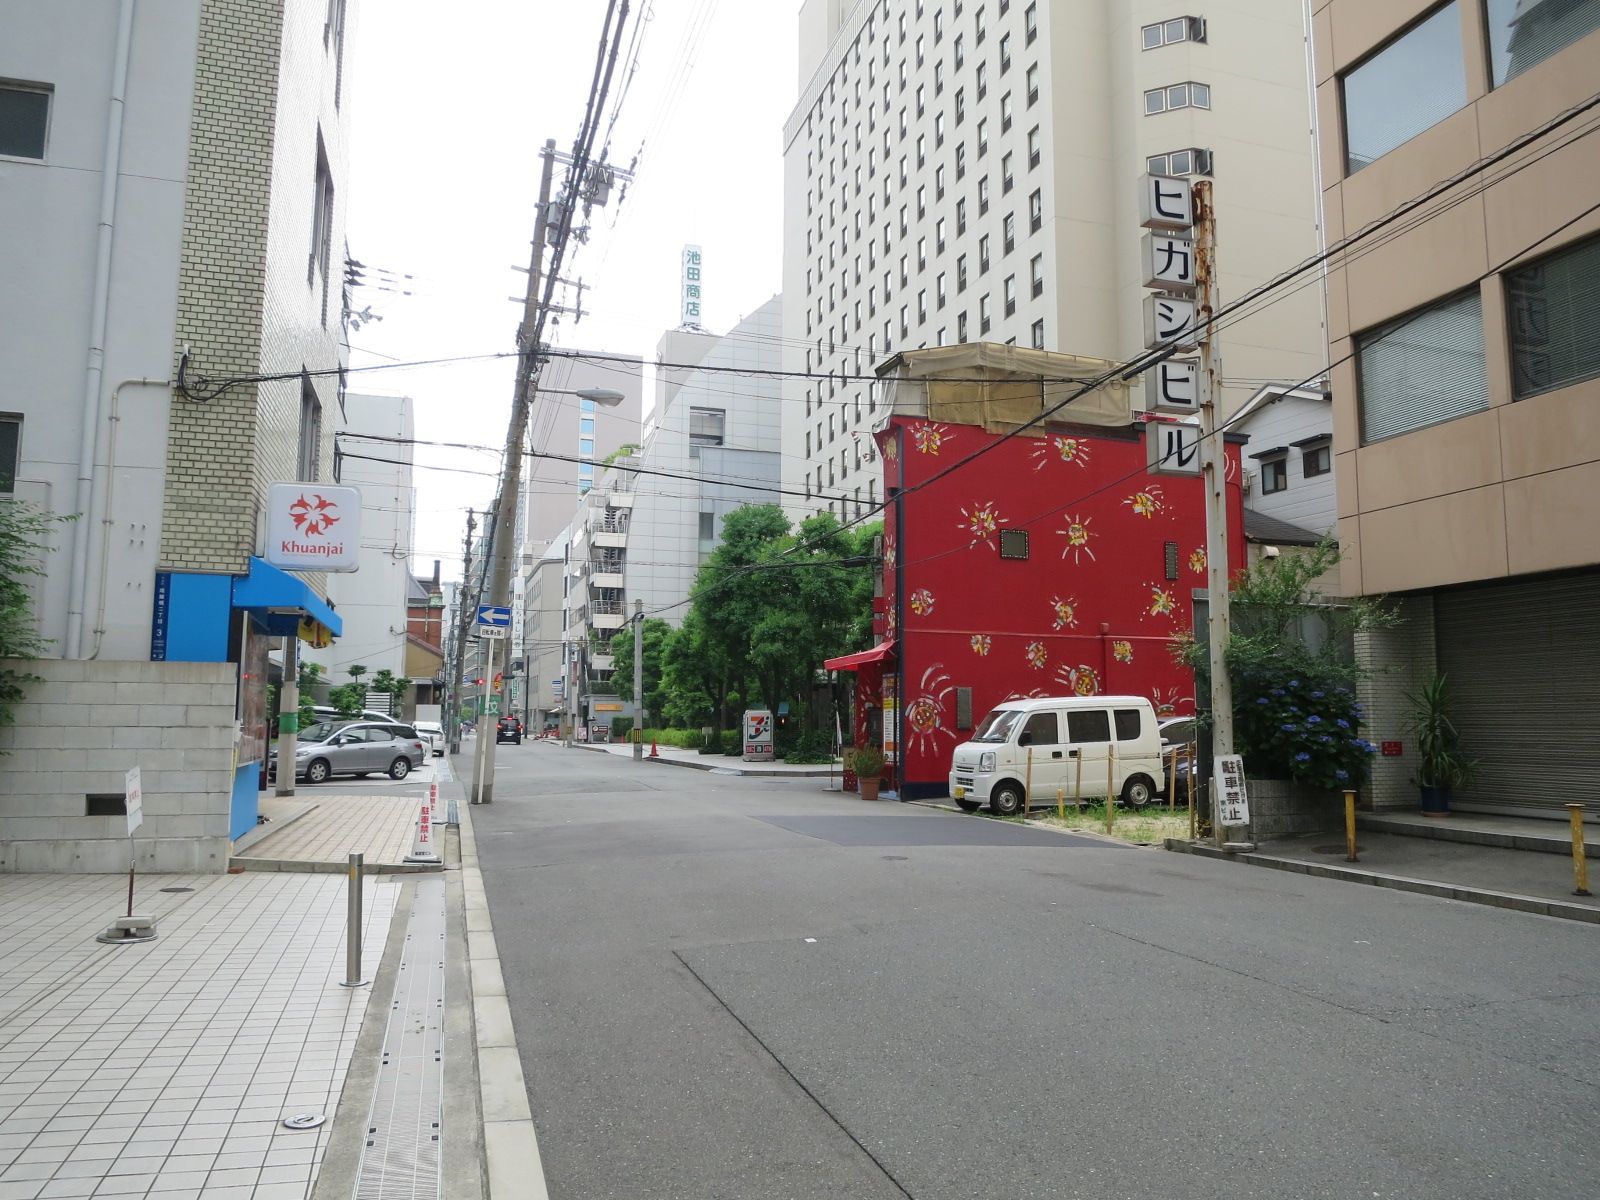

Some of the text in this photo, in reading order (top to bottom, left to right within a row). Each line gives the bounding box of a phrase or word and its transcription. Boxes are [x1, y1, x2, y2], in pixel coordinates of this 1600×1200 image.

[686, 250, 701, 317] 池田商店
[1154, 180, 1198, 468] ヒガシビル
[282, 540, 343, 558] Khuanjai
[1221, 760, 1242, 821] 駐車禁止
[420, 806, 430, 843] 駐車禁止
